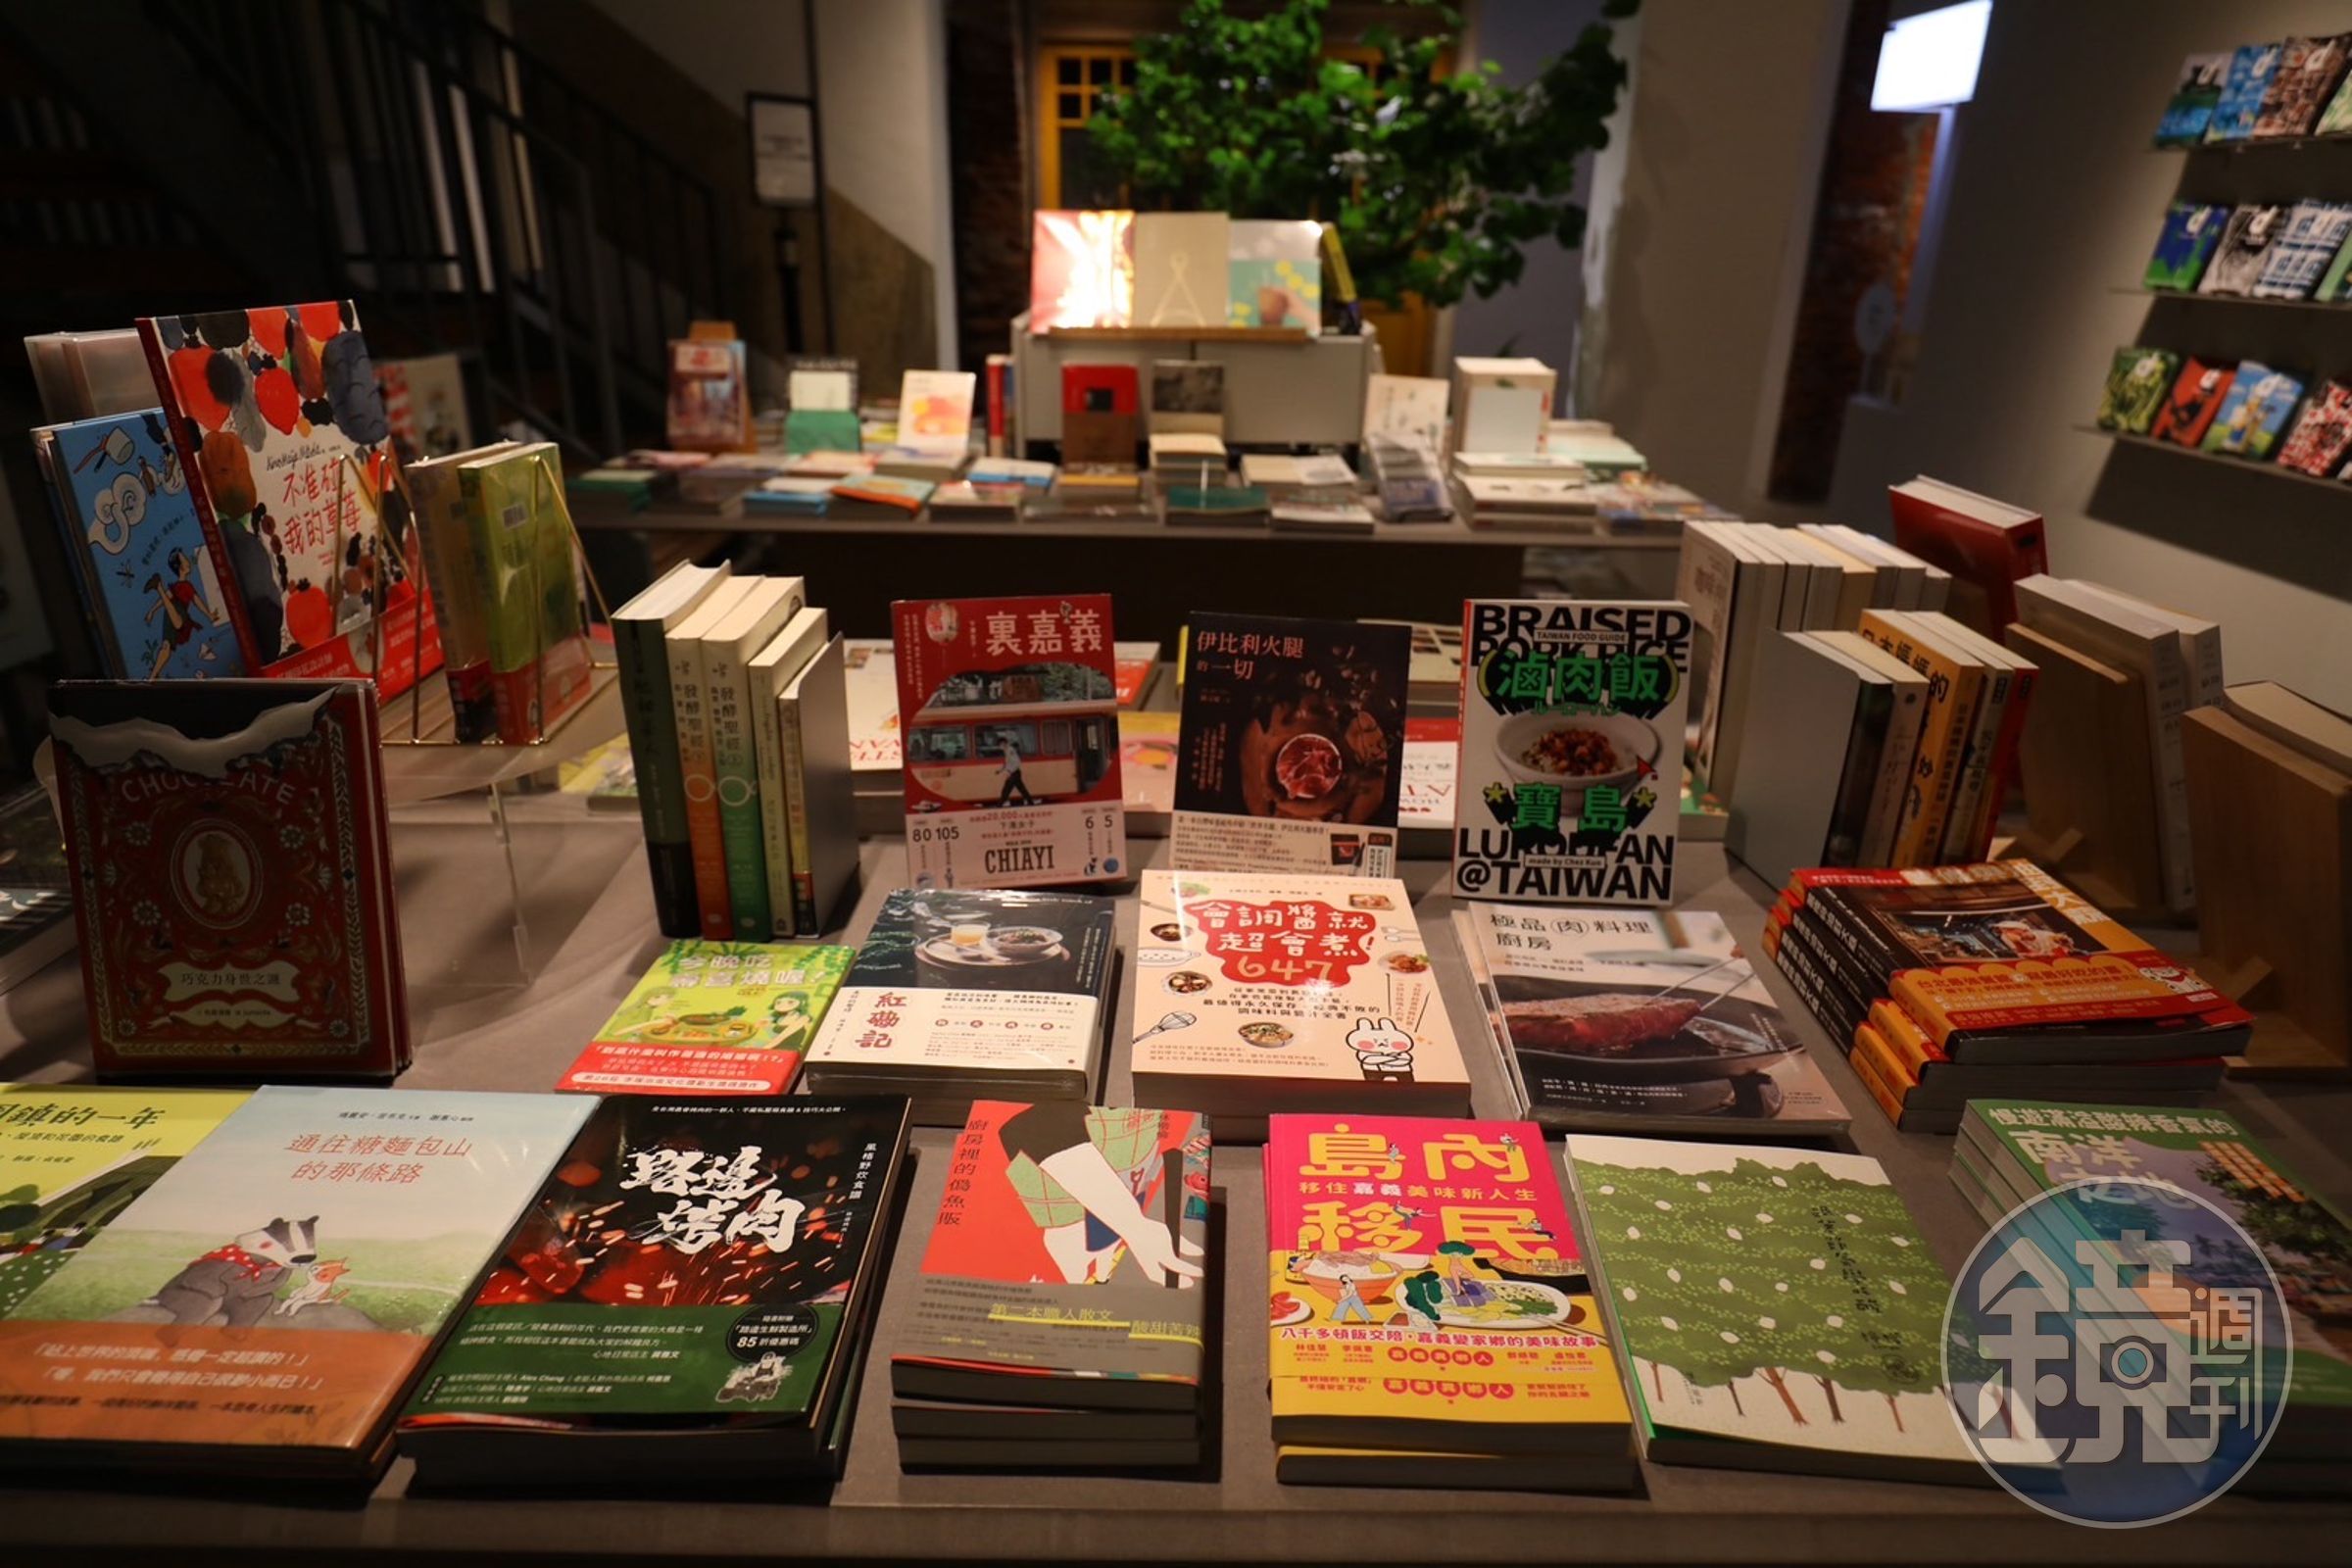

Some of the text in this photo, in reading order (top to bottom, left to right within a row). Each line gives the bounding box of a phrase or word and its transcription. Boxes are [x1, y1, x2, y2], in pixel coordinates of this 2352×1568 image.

[282, 457, 347, 504] 不准碰
[283, 490, 363, 557] 我的草莓
[986, 609, 1102, 656] 裏嘉義
[1474, 605, 1691, 642] BRAISED
[1536, 631, 1627, 642] TAIWAN FOOD GUIDE
[1197, 630, 1304, 659] 伊比利火腿
[1196, 659, 1255, 681] 的一切
[912, 827, 932, 843] 80
[935, 825, 959, 841] 105
[984, 845, 1055, 874] CHIAYI
[1456, 859, 1672, 901] @TAIWAN
[1190, 900, 1370, 932] 會調醬就
[1490, 912, 1655, 935] 極品肉料理
[1495, 932, 1553, 953] 廚房
[679, 953, 773, 969] 今晚吃
[1237, 955, 1334, 981] 647
[282, 1133, 474, 1158] 通往糖麵包山
[1298, 1123, 1532, 1183] 島內
[2007, 1129, 2144, 1169] 南洋
[289, 1159, 425, 1185] 的那條路
[1298, 1181, 1538, 1202] 移住嘉義美味新人生
[1298, 1201, 1560, 1261] 移民
[736, 1336, 759, 1349] 85
